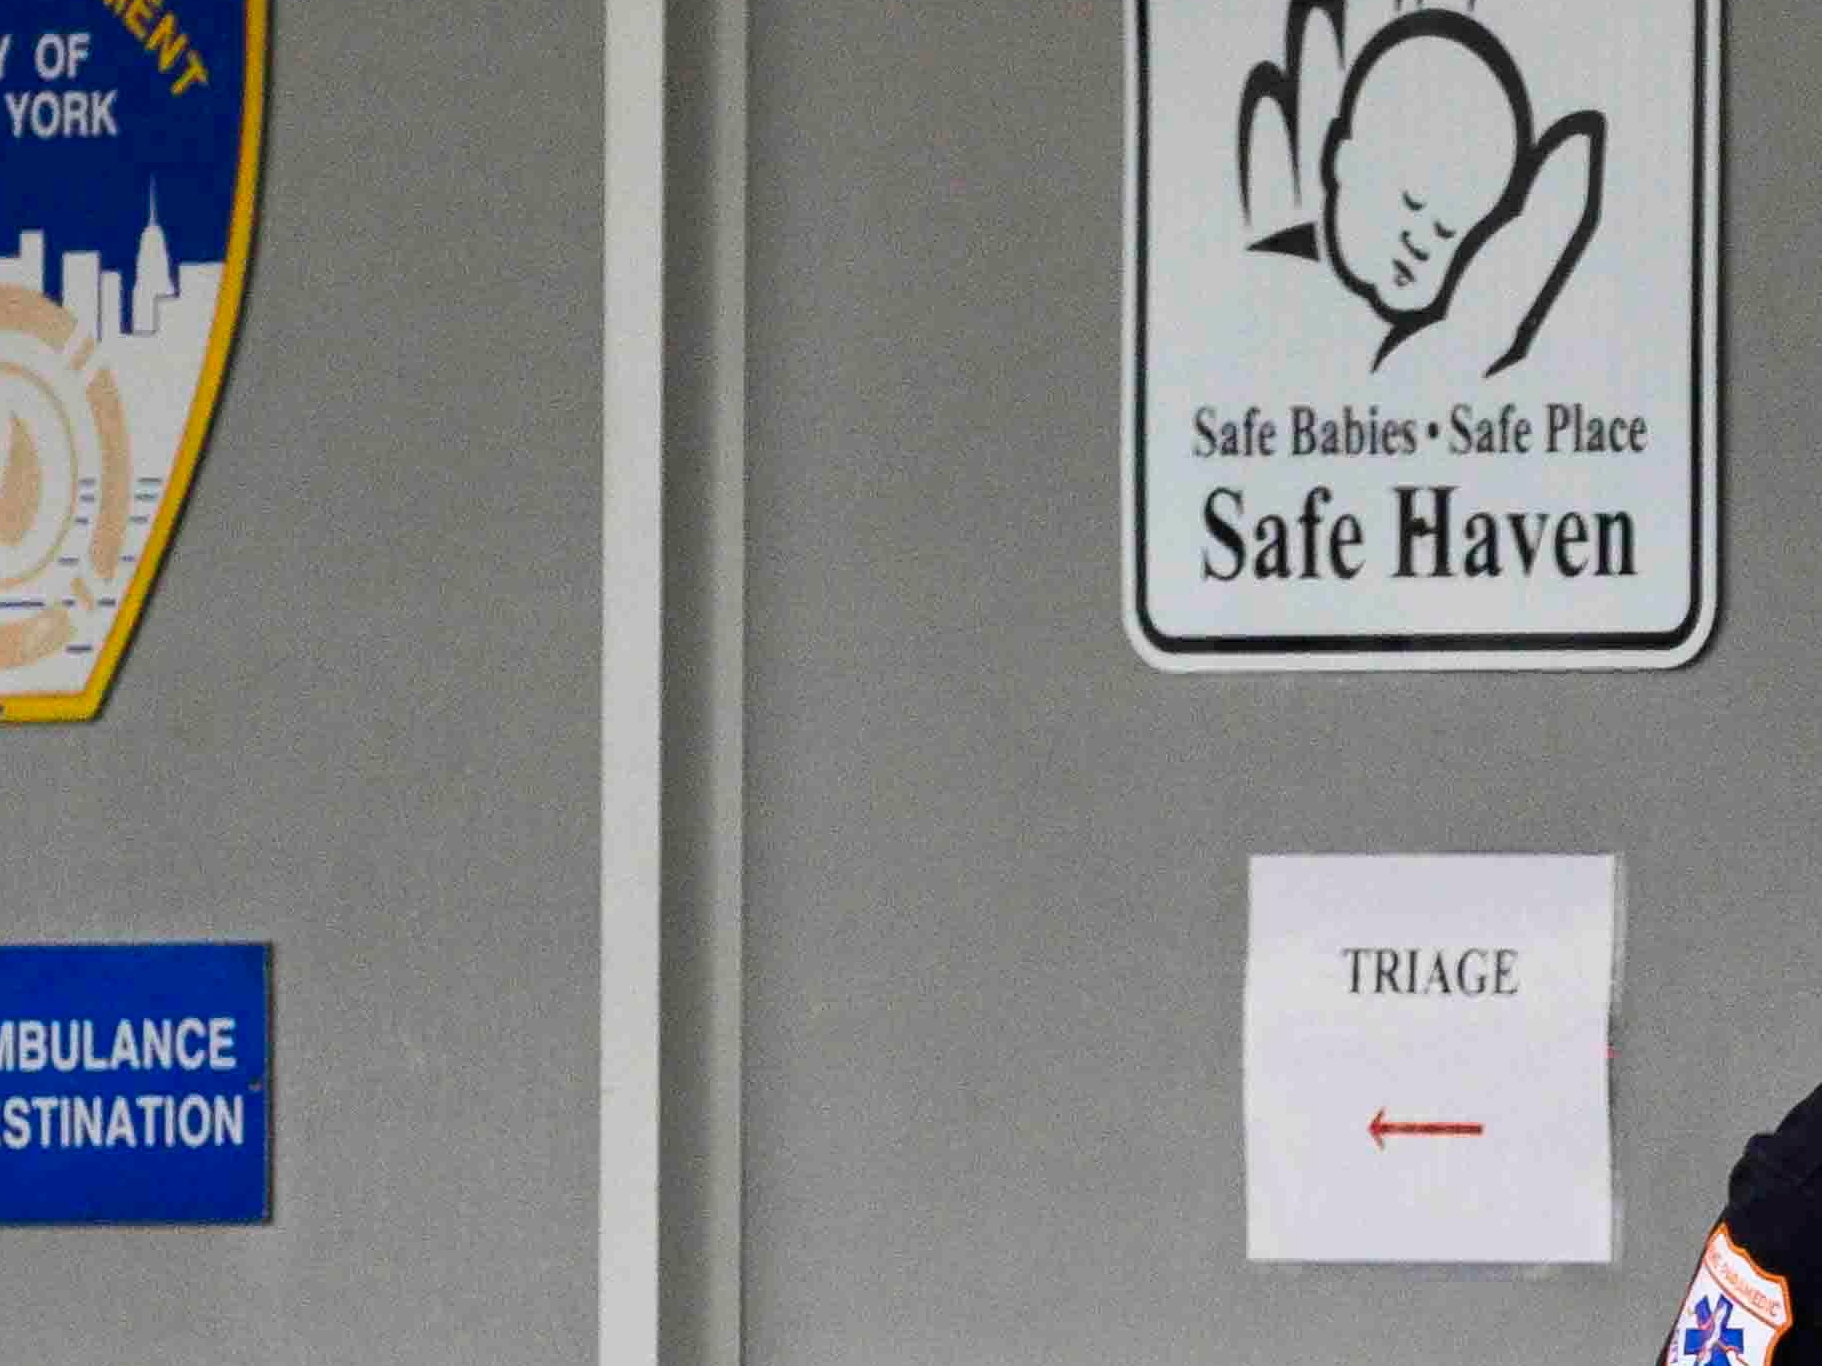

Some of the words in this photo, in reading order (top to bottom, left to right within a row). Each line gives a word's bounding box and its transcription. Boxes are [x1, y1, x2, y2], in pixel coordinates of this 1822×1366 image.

[34, 32, 90, 79] OF
[4, 89, 118, 139] YORK
[1192, 405, 1277, 459] Safe
[1290, 404, 1418, 458] Babies
[1448, 402, 1532, 455] Safe
[1545, 402, 1649, 455] Place
[1201, 485, 1366, 582] Safe
[1391, 485, 1639, 580] Haven
[1342, 947, 1520, 996] TRIAGE
